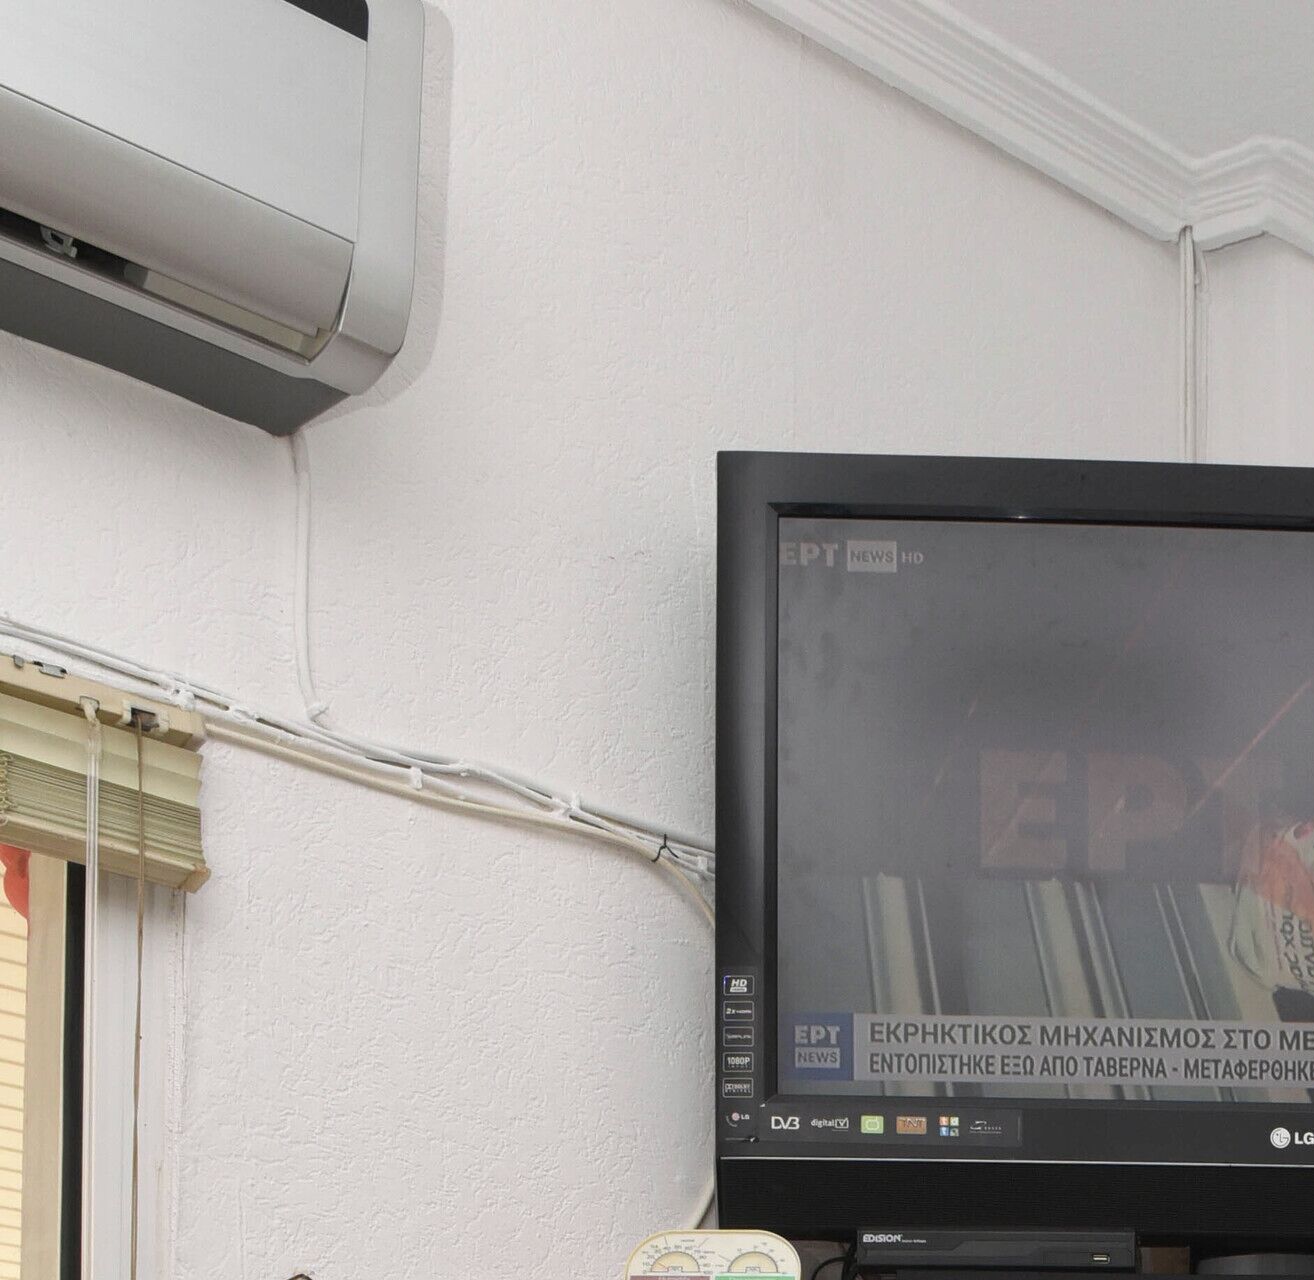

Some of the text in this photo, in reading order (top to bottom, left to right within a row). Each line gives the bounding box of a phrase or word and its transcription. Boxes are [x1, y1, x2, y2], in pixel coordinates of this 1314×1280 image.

[779, 542, 839, 568] ΕΡΤ
[849, 549, 924, 566] NEWS HD
[731, 979, 748, 988] HD
[794, 1024, 841, 1045] ΕΡΤ
[869, 1022, 1033, 1046] ΕΚΡΗΚΤΙΚΟΣ
[1039, 1024, 1216, 1049] ΜΗΧΑΝΙΣΜΟΣ
[1223, 1028, 1272, 1051] ΣΤΟ
[726, 1056, 751, 1065] 1080P
[796, 1051, 839, 1065] NEWS
[869, 1052, 996, 1075] ΕΝΤΟΠΙΣΤΗΚΕ
[1000, 1055, 1035, 1076] ΕΞΩ
[1039, 1055, 1078, 1077] ΑΠΟ
[1083, 1056, 1168, 1078] ΤΑΒΕΡΝΑ
[770, 1116, 801, 1130] DVB
[862, 1233, 902, 1243] EDISION
